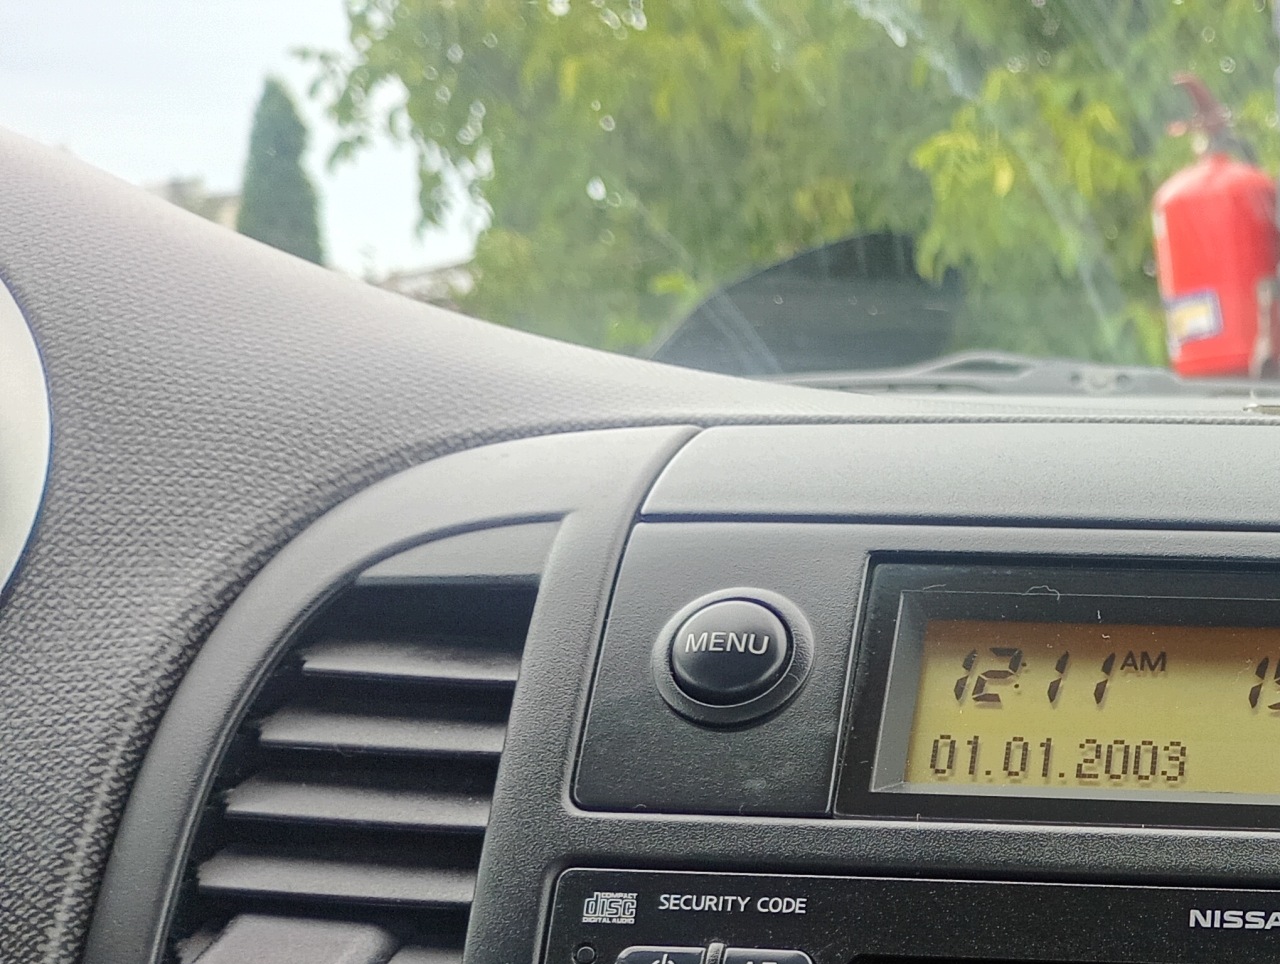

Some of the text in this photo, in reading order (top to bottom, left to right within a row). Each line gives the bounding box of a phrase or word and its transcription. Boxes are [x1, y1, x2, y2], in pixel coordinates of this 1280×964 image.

[684, 631, 770, 655] MENU
[953, 647, 1168, 704] 12:11 AM
[929, 734, 1187, 782] 01.01.2003
[658, 894, 808, 914] SECURITY CODE
[582, 916, 635, 925] DIGITAL AUDIO
